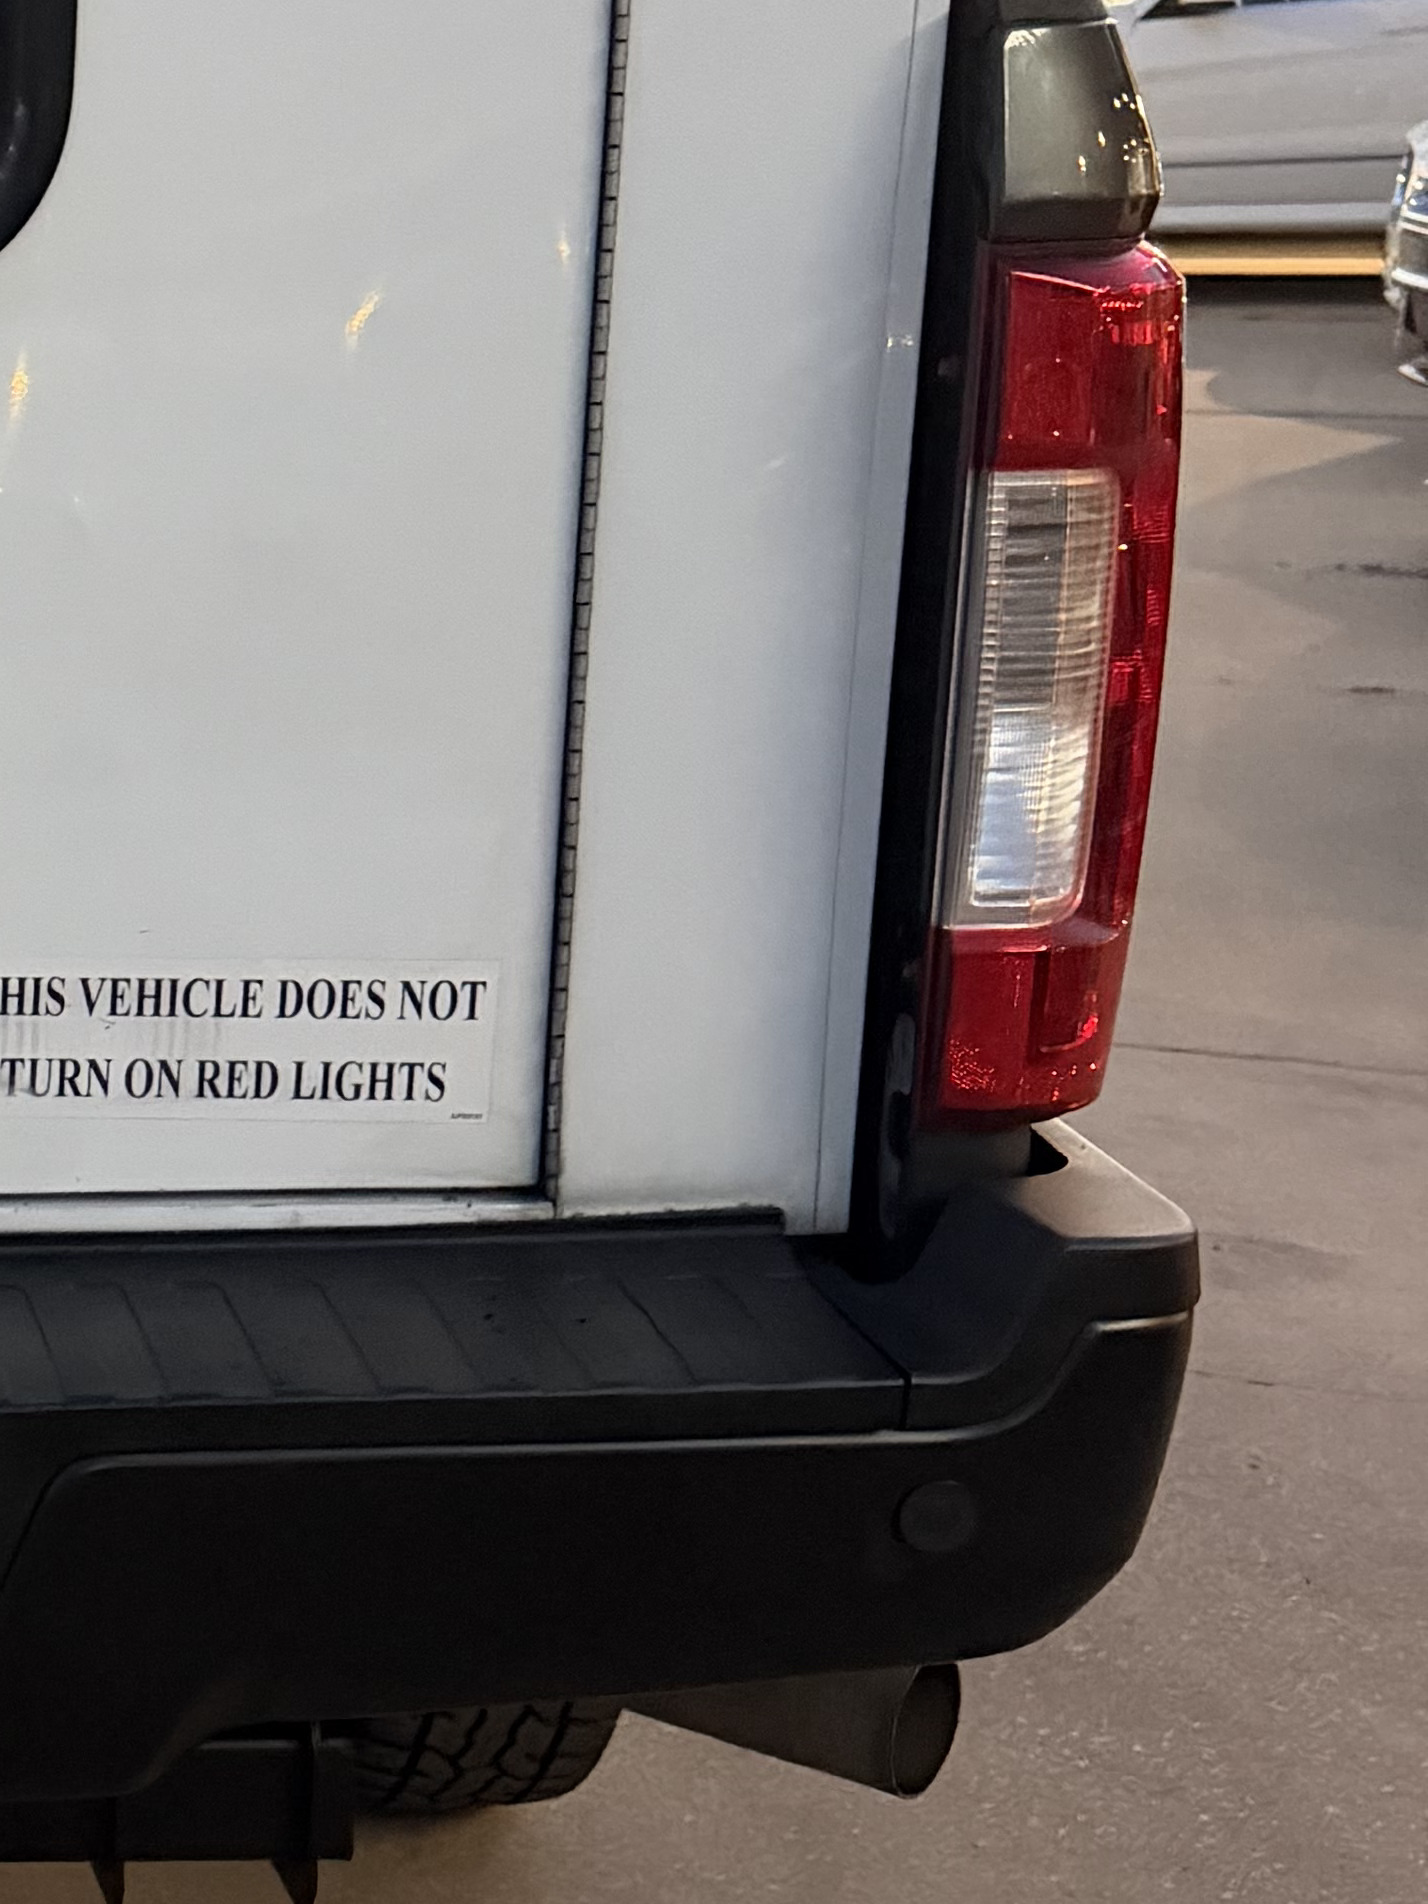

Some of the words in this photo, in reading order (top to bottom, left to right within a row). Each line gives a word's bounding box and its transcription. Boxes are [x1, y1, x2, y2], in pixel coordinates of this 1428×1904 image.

[78, 976, 263, 1019] VEHICLE
[274, 978, 386, 1021] DOES
[397, 979, 487, 1022] NOT
[0, 1057, 112, 1098] TURN
[123, 1058, 182, 1099] ON
[195, 1059, 279, 1100] RED
[290, 1060, 447, 1103] LIGHTS
